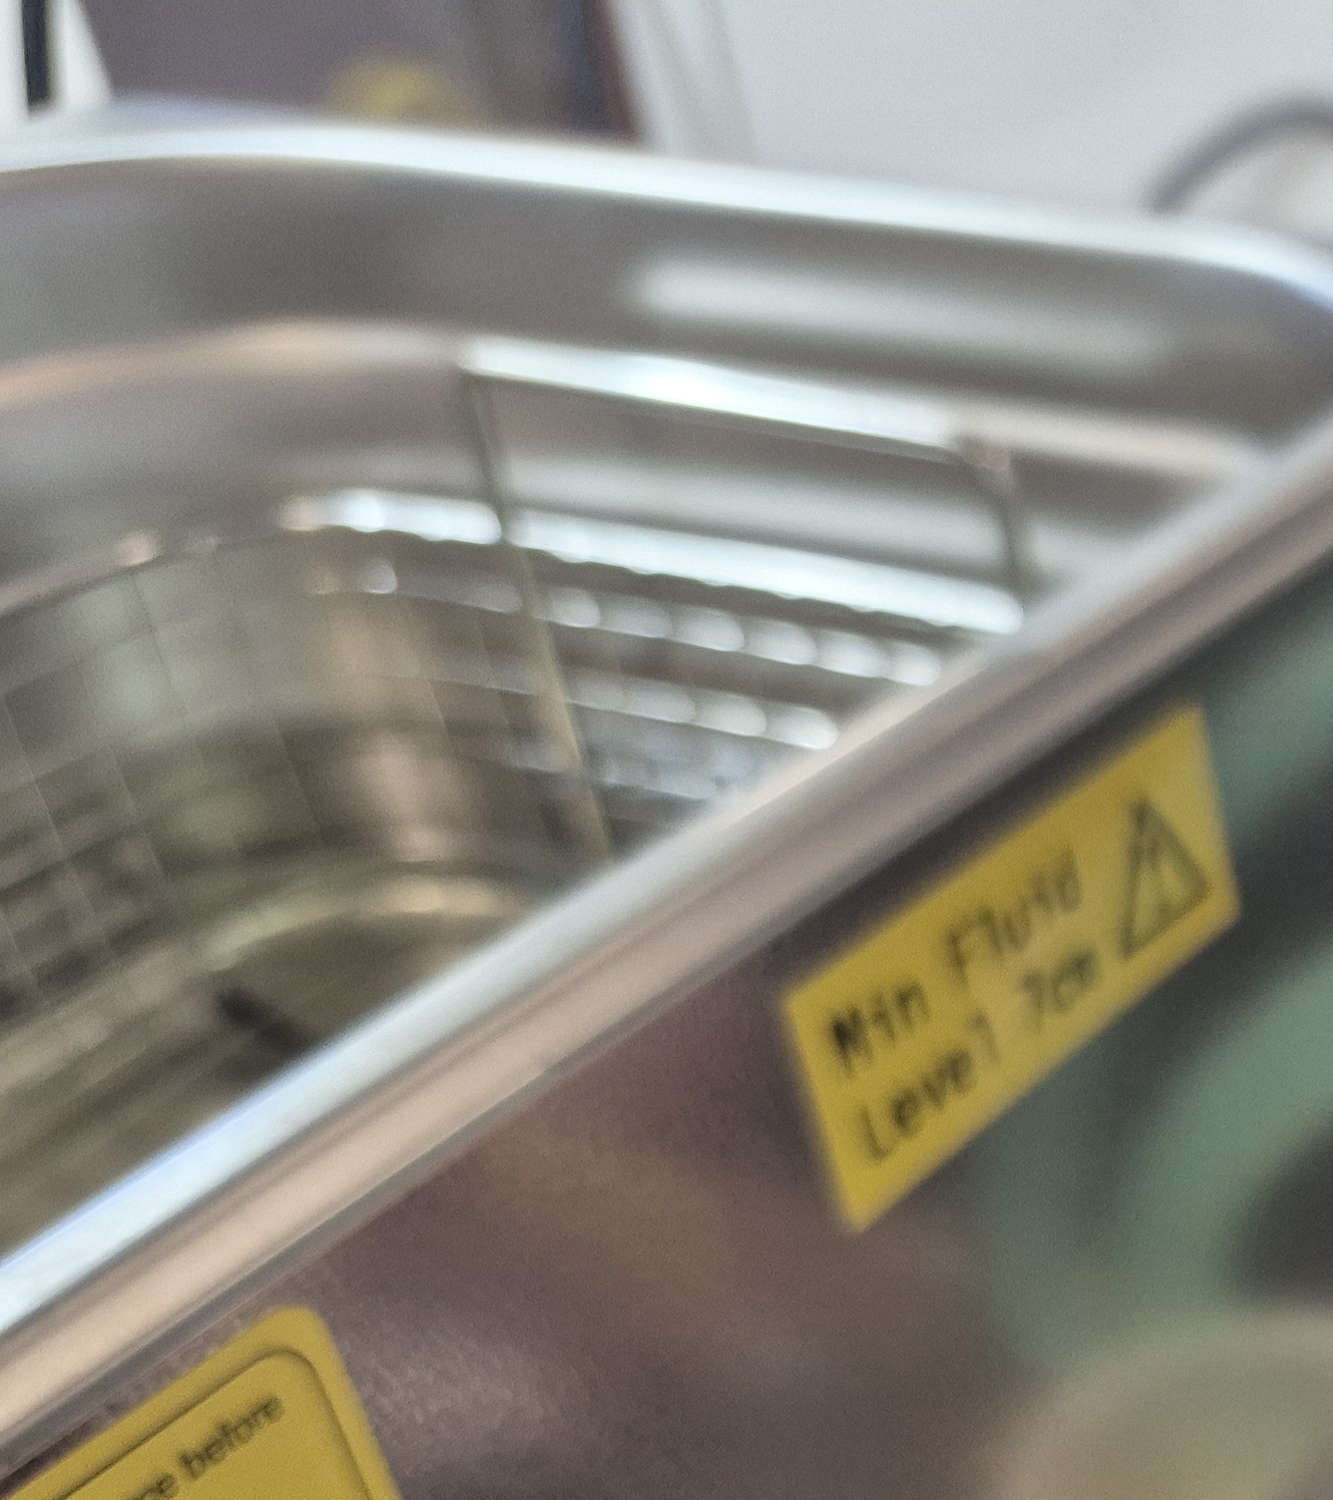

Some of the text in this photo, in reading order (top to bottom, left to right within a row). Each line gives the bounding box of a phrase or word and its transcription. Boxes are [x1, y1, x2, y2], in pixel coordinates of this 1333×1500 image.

[945, 843, 1083, 993] Fluid
[858, 1008, 999, 1165] Level
[179, 1397, 285, 1480] before
